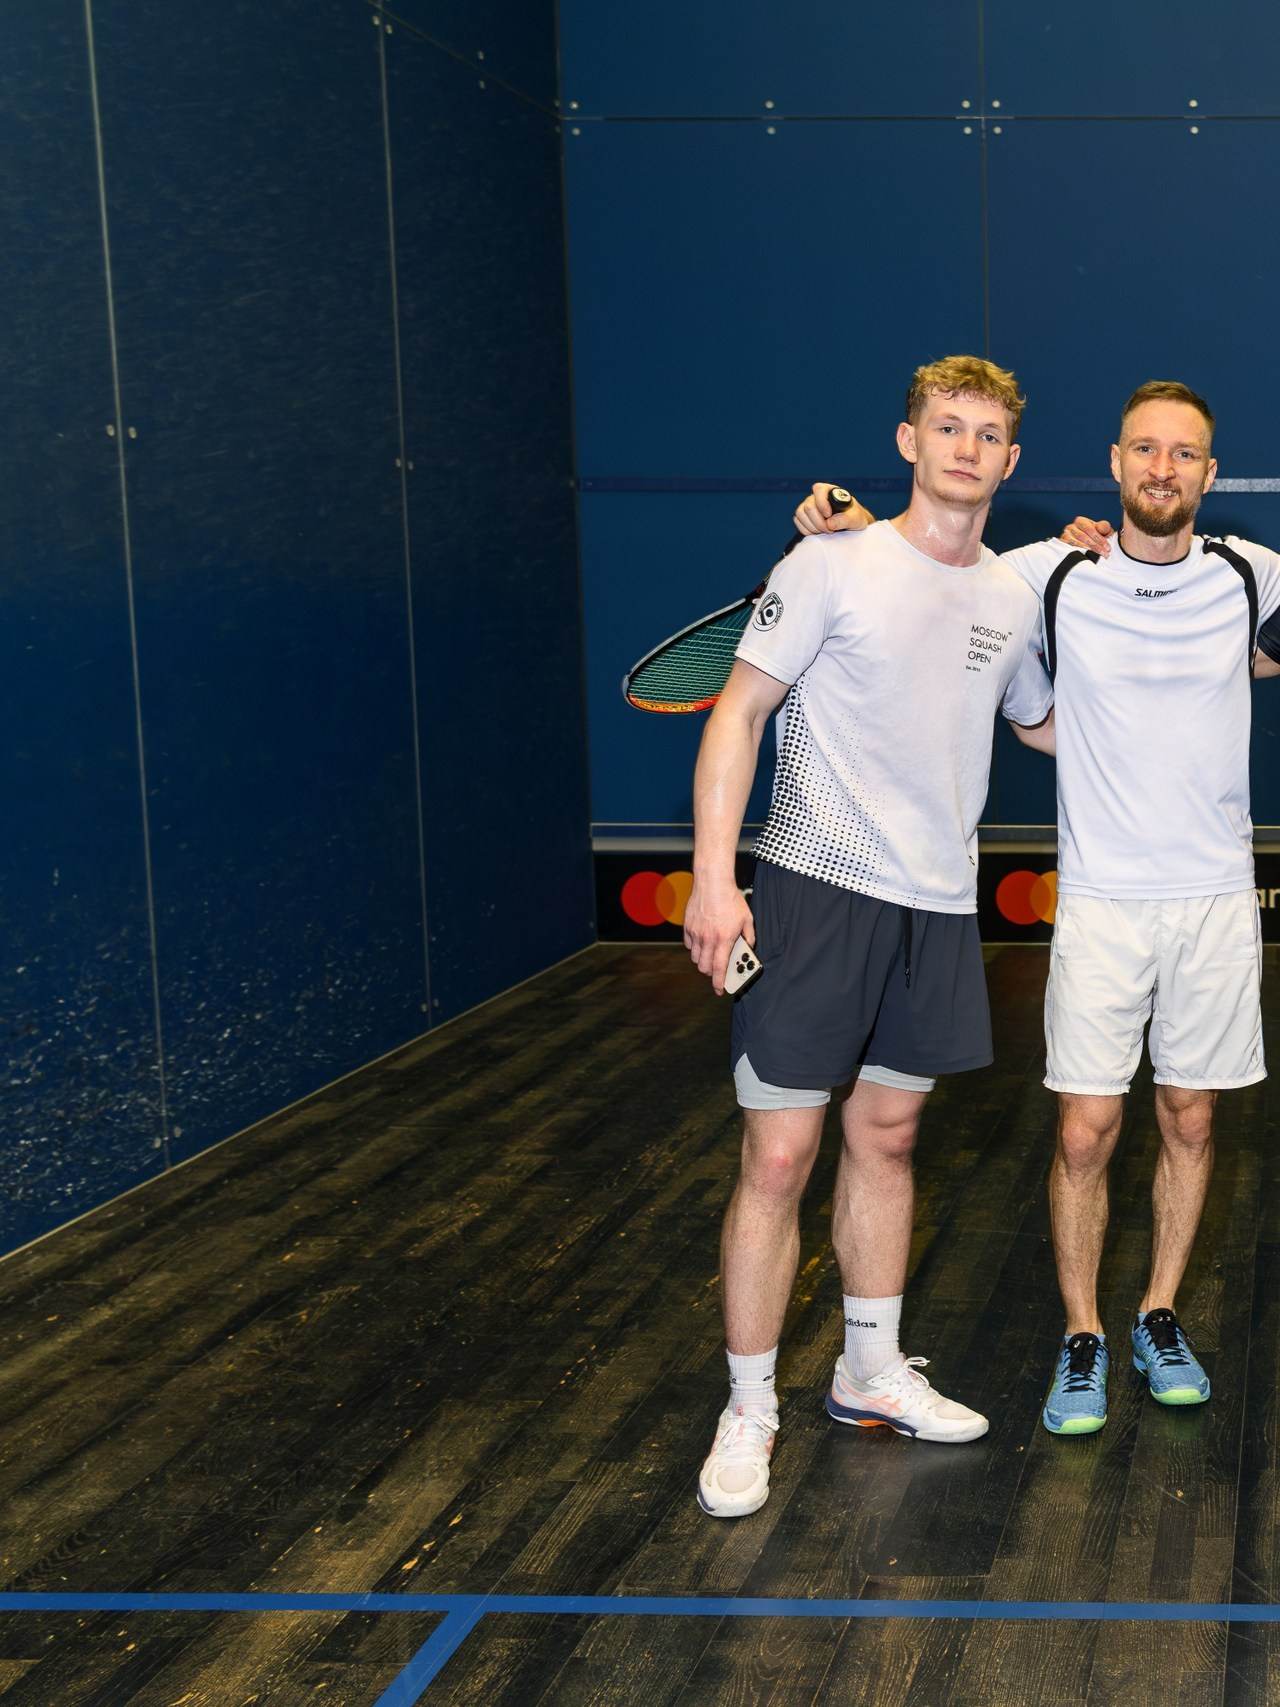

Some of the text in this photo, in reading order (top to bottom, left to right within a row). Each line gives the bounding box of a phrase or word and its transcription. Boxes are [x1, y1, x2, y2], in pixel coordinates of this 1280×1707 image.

[971, 624, 1008, 642] MOSCOW
[969, 637, 1002, 654] SQUASH
[968, 650, 991, 664] OPEN
